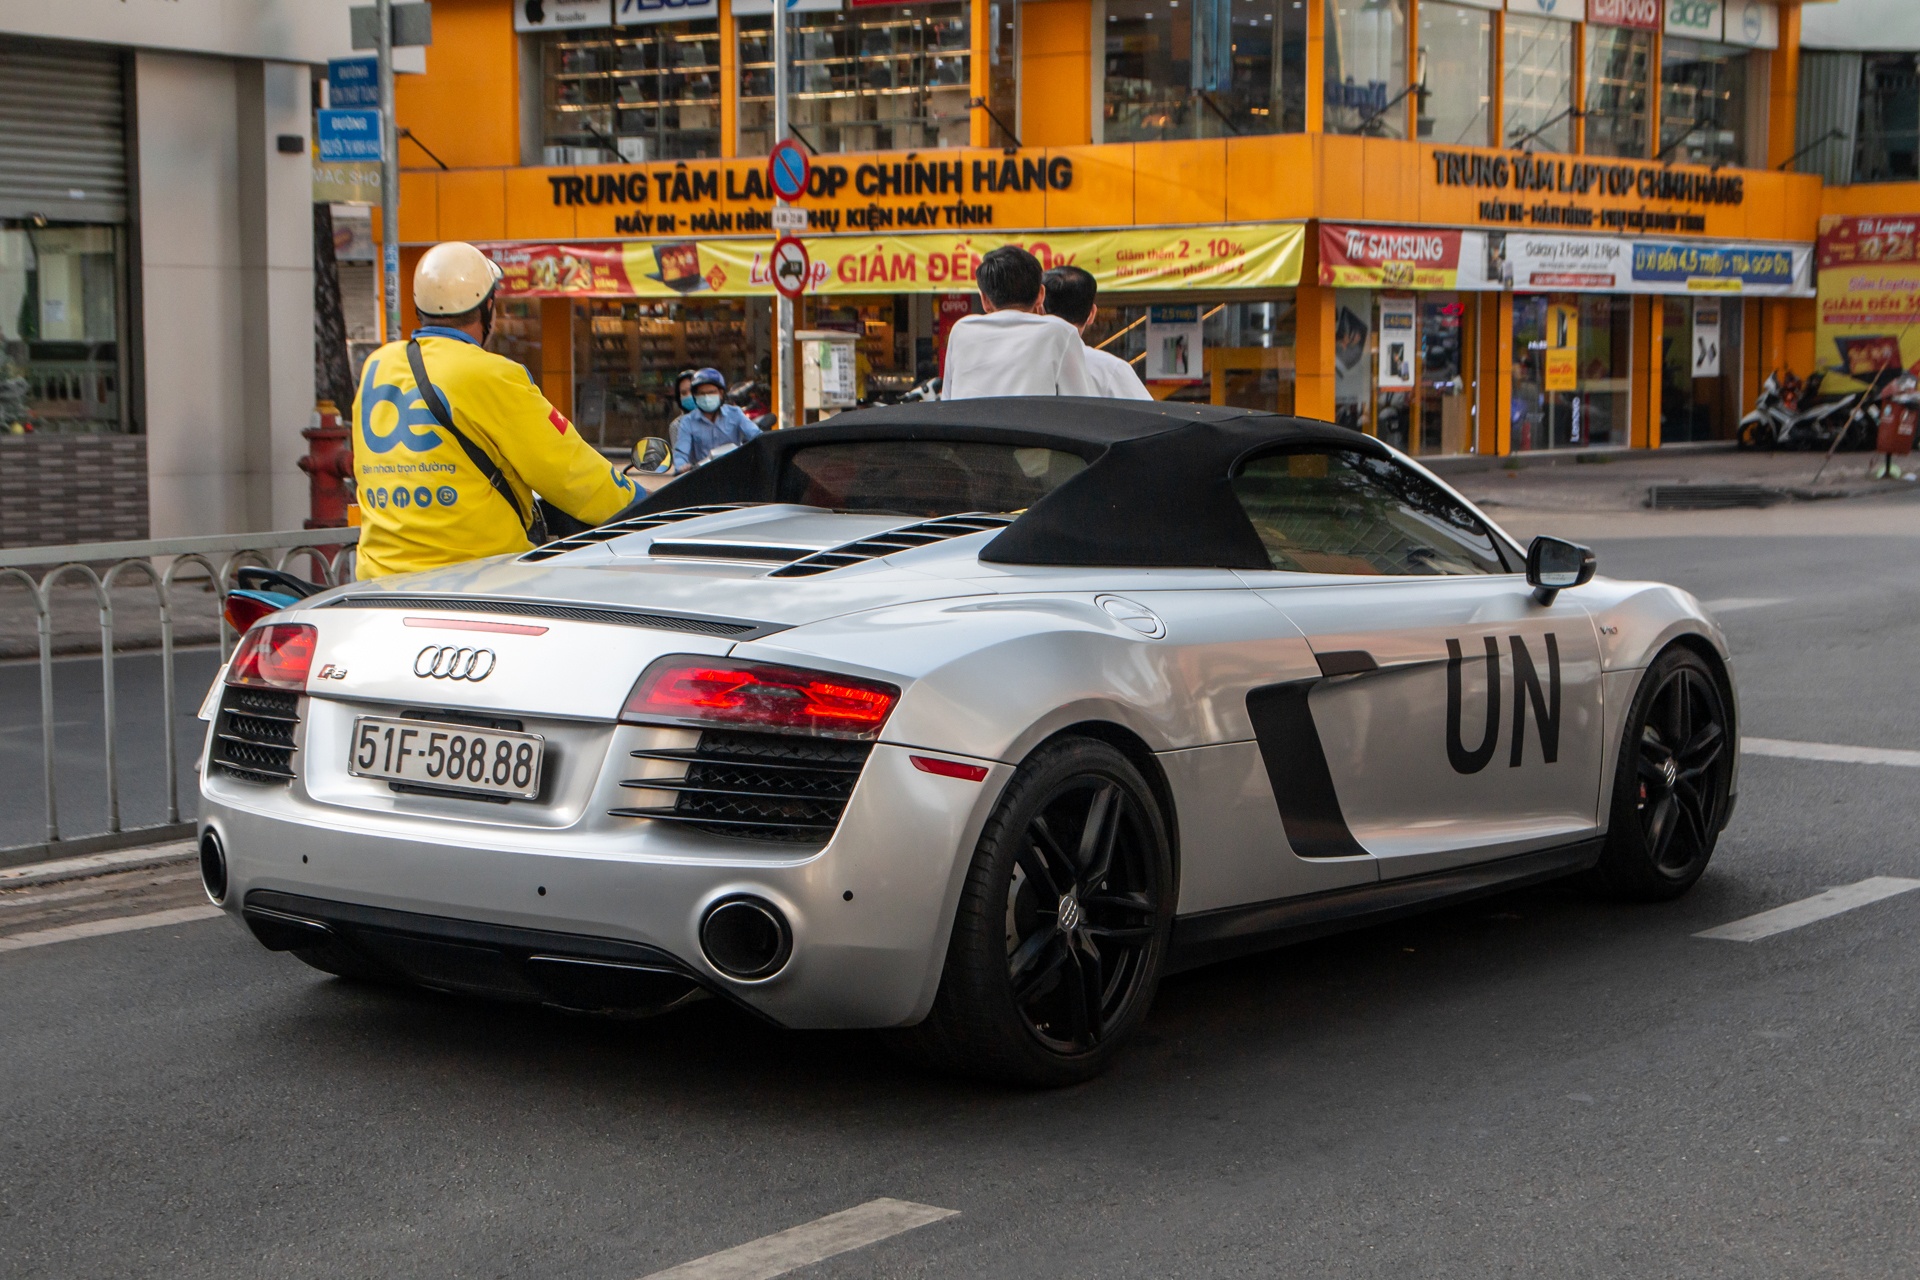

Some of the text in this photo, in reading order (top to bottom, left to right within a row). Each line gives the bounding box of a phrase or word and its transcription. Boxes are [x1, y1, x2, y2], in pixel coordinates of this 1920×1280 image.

[1595, 0, 1656, 23] Lenovo
[1670, 0, 1718, 29] acer
[349, 169, 381, 187] SHO
[548, 147, 1073, 206] TRUNG TÂM LAOP CHÍNH HÃNG
[1433, 151, 1509, 189] TRUNG
[1512, 151, 1554, 192] TÂM
[1558, 160, 1634, 197] LAPTOP
[615, 209, 654, 234] MÁY
[656, 213, 676, 233] IN
[690, 207, 733, 232] MÀN
[736, 206, 772, 231] HÌN
[808, 208, 840, 233] HỤ
[847, 202, 893, 232] KIỆN
[897, 201, 941, 226] MÁY
[943, 199, 993, 225] TÍNH
[1479, 196, 1506, 222] MÁY
[1508, 202, 1523, 222] IN
[1531, 199, 1561, 224] MÀN
[1875, 218, 1915, 239] Laptop
[1116, 248, 1145, 261] Giảm
[1147, 247, 1175, 259] thêm
[1178, 239, 1190, 259] 2
[1207, 238, 1246, 259] 10%
[1346, 229, 1443, 261] Tết SAMSUNG
[1525, 240, 1558, 261] Galaxy
[837, 244, 916, 283] GIẢM
[1183, 260, 1214, 278] phẩm
[941, 300, 969, 313] OPPO
[1823, 293, 1863, 310] GIẢM
[361, 359, 452, 454] be
[374, 464, 396, 473] nhau
[397, 463, 416, 475] trọn
[418, 461, 456, 475] đường
[1600, 625, 1618, 636] V10
[318, 663, 348, 680] R8
[1445, 632, 1562, 775] UN
[357, 724, 533, 788] 51F-588.88
